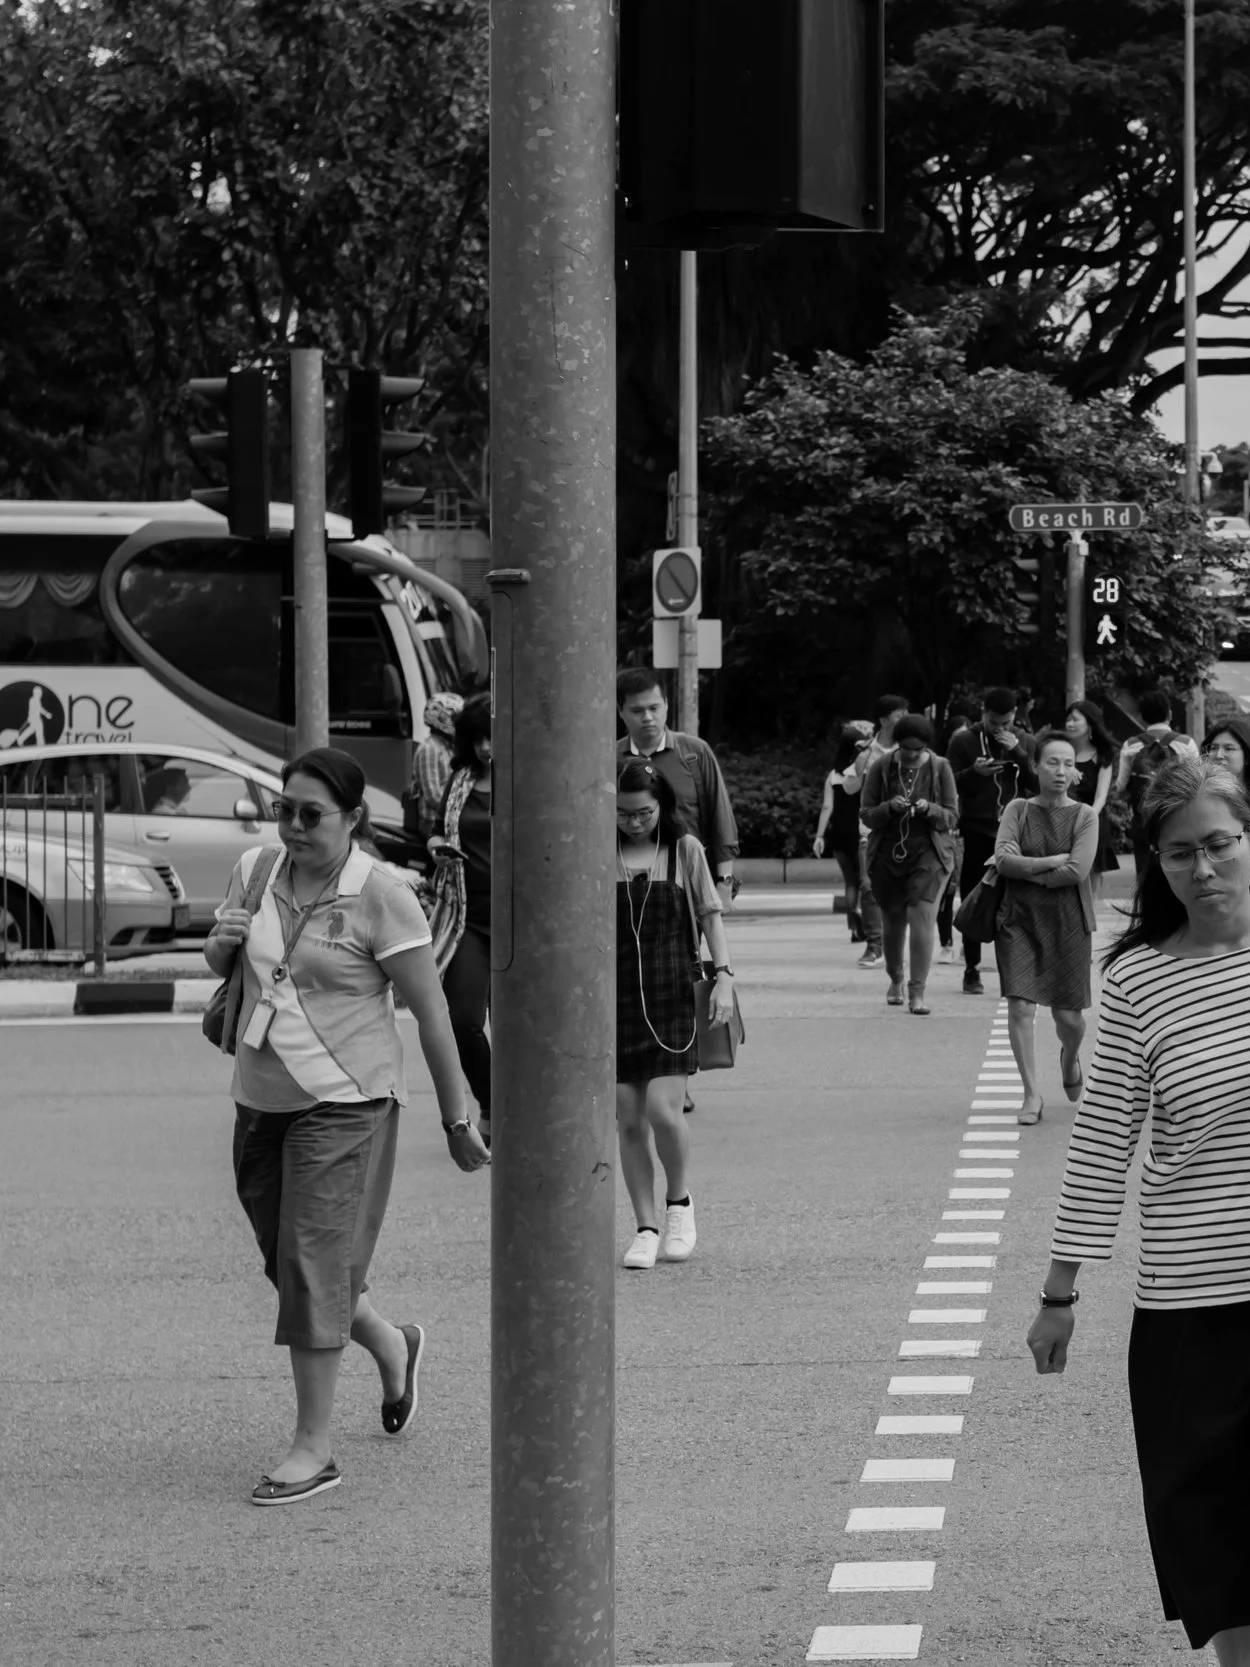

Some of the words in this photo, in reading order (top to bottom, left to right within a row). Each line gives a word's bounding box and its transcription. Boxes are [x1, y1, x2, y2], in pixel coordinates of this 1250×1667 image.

[1022, 507, 1093, 528] Beach
[1103, 507, 1130, 526] Rd
[1093, 578, 1119, 603] 28
